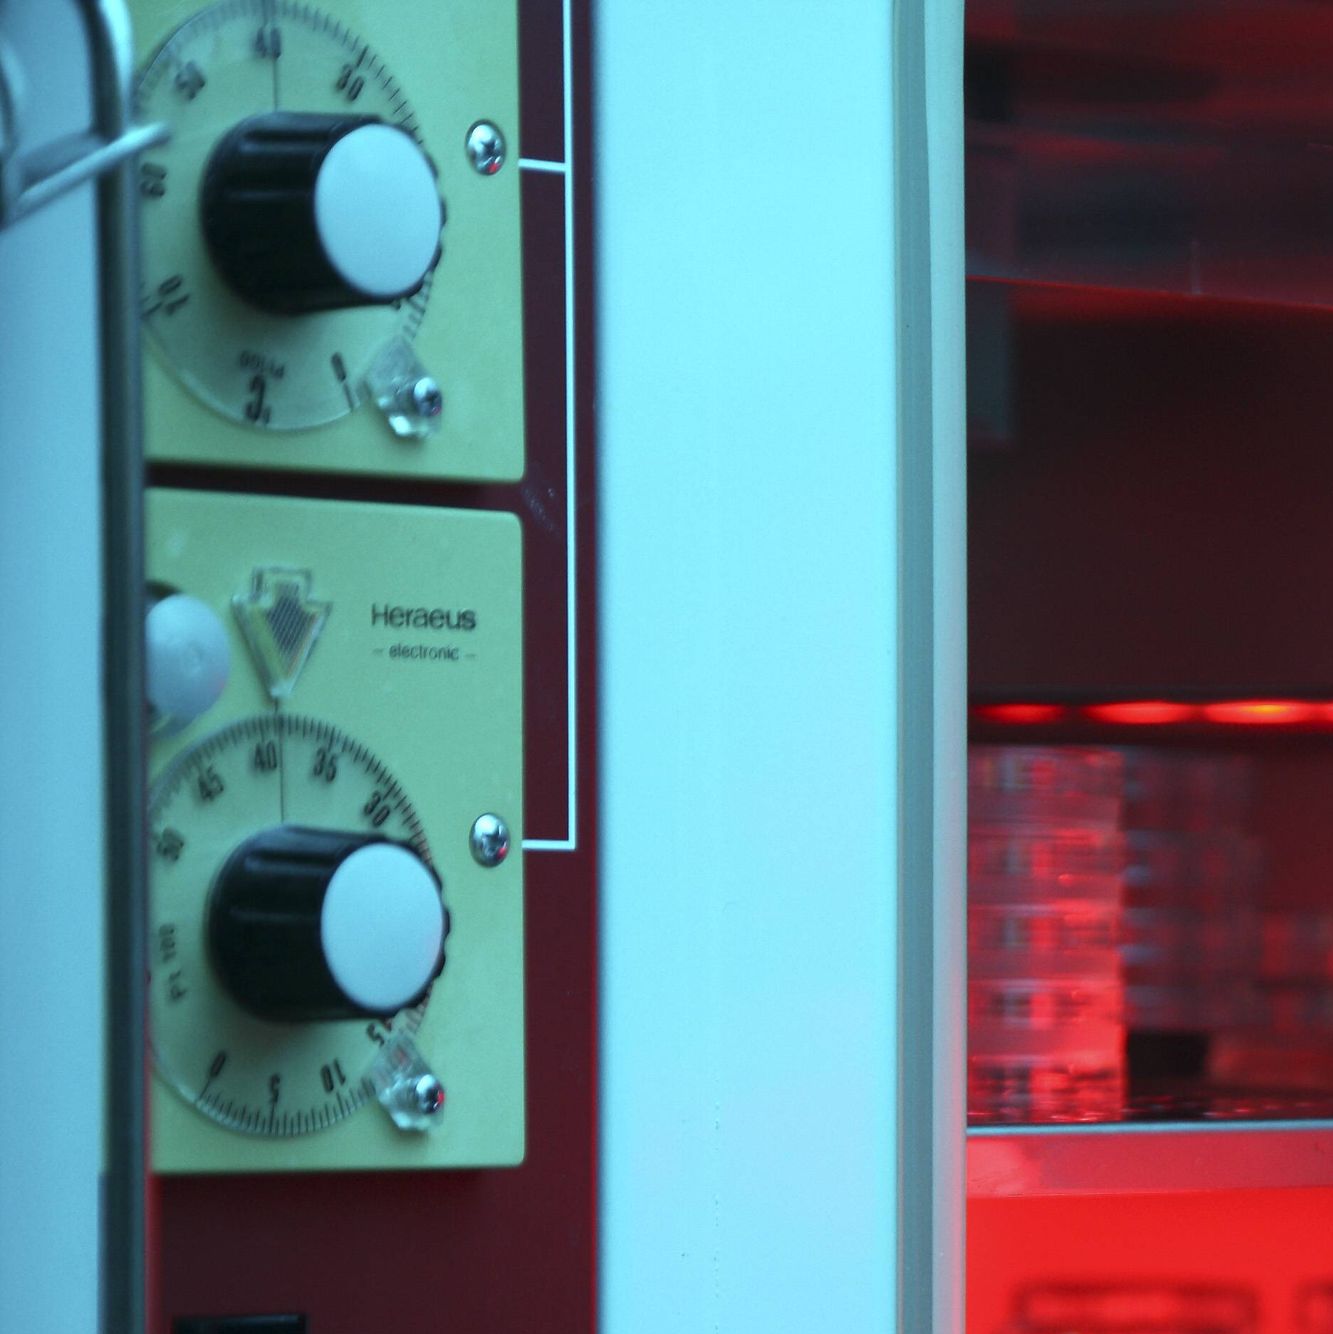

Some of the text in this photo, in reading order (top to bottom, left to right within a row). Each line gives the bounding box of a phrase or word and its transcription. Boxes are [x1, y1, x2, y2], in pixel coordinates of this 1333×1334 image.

[371, 603, 477, 630] Heraeus
[388, 643, 460, 661] electronic
[254, 740, 278, 771] 40
[313, 748, 337, 783] 35
[198, 765, 224, 801] 45
[364, 790, 391, 828] 30
[320, 1058, 347, 1093] 10
